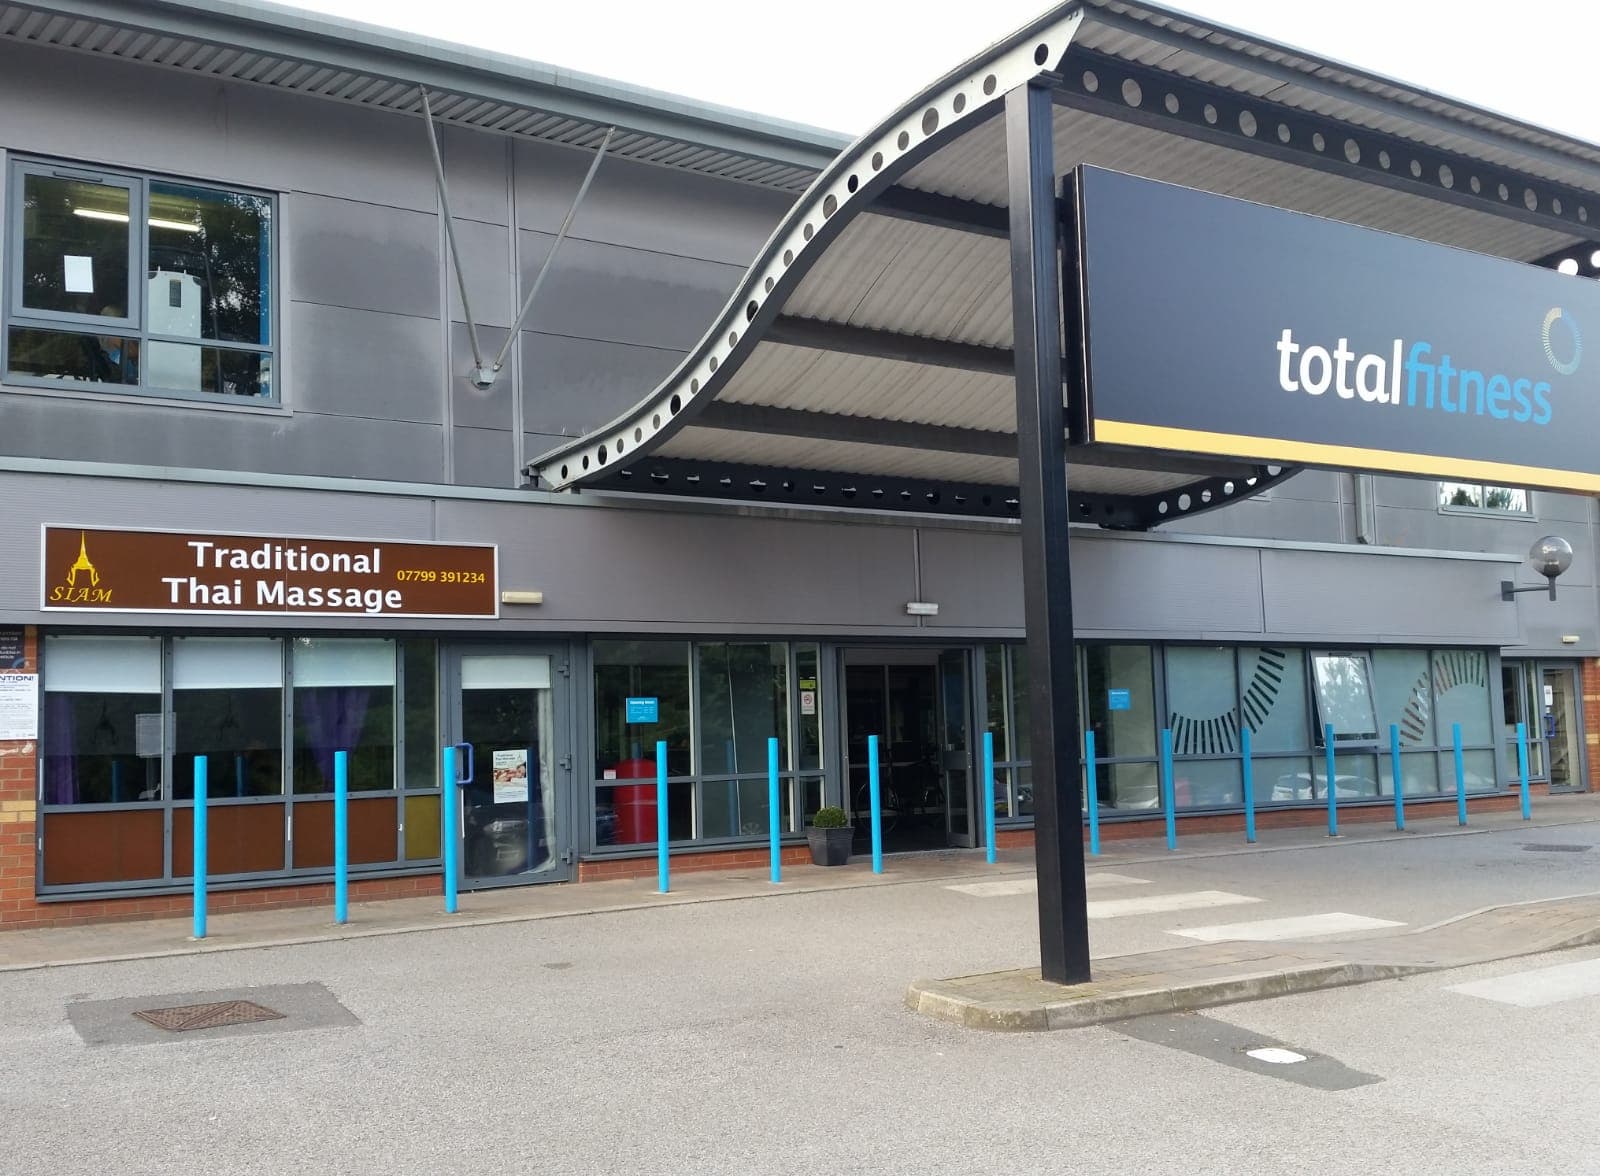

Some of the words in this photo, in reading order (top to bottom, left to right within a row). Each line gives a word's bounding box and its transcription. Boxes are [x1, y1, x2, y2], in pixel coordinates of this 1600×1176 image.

[188, 541, 381, 573] Traditional
[397, 570, 436, 582] 07799
[440, 571, 486, 583] 391234
[50, 586, 113, 603] SIAM
[161, 576, 242, 605] Thai
[256, 580, 402, 613] Massage
